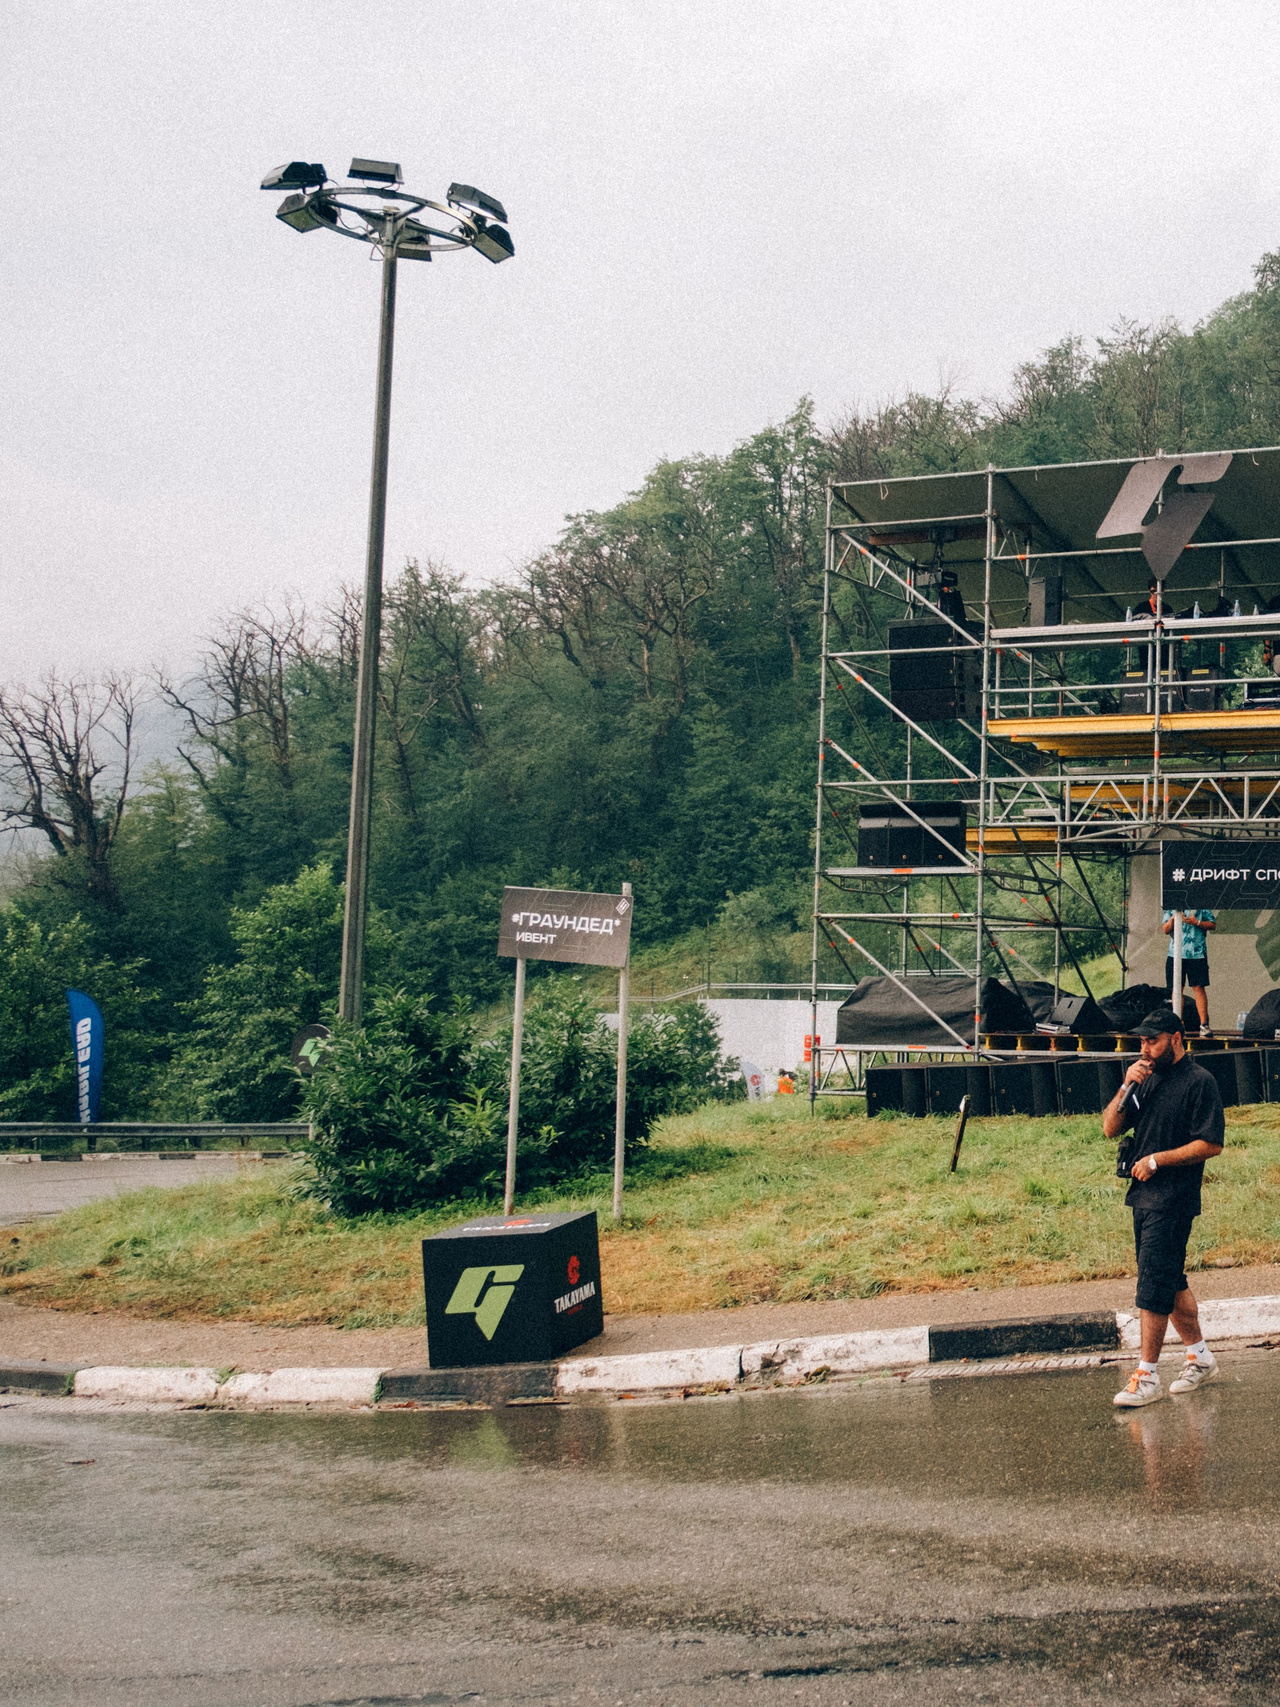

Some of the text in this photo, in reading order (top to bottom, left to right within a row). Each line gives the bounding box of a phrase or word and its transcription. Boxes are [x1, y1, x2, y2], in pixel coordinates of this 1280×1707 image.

[1190, 869, 1250, 882] ДРИФТ
[515, 931, 557, 944] ИВЕНТ
[554, 1281, 596, 1313] TAKAYAMA
